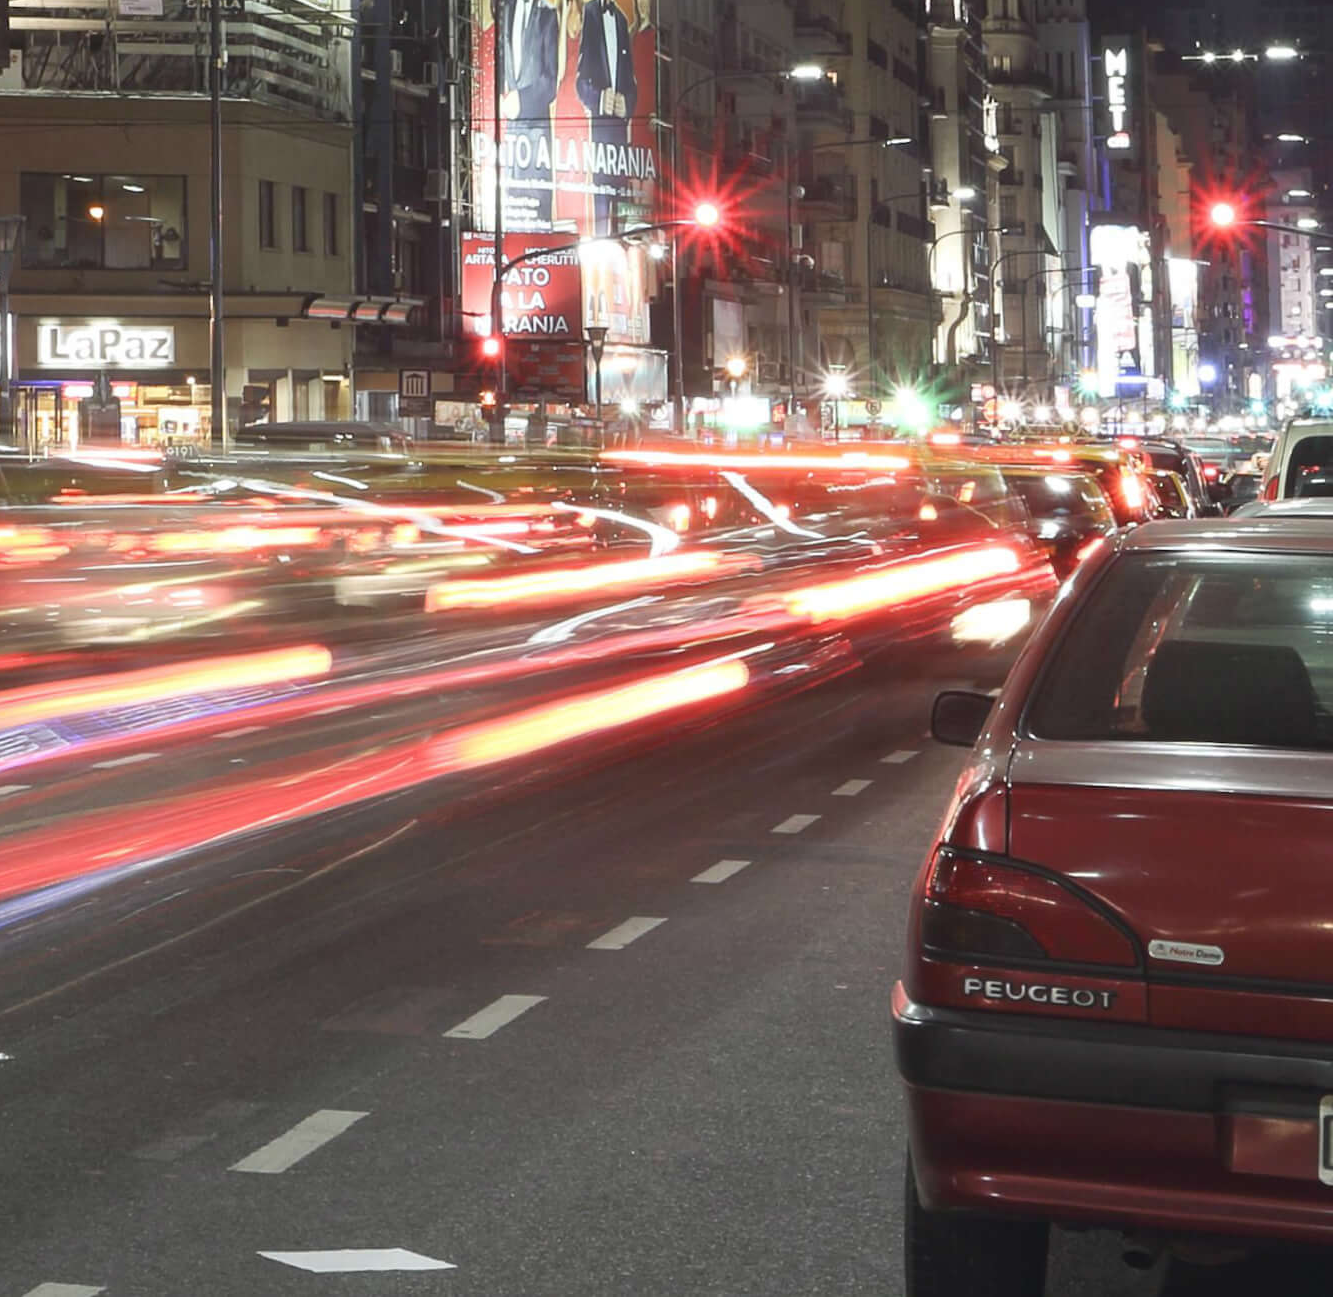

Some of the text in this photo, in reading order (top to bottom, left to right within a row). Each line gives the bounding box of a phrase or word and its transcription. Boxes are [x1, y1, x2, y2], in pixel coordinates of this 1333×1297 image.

[1104, 47, 1128, 132] MET
[536, 135, 551, 170] A
[554, 137, 581, 172] LA
[582, 140, 656, 180] NARANJA
[464, 254, 510, 265] ARTAA
[517, 291, 545, 310] LA
[474, 315, 569, 337] NRANJA
[964, 977, 1118, 1009] PEUGEOT
